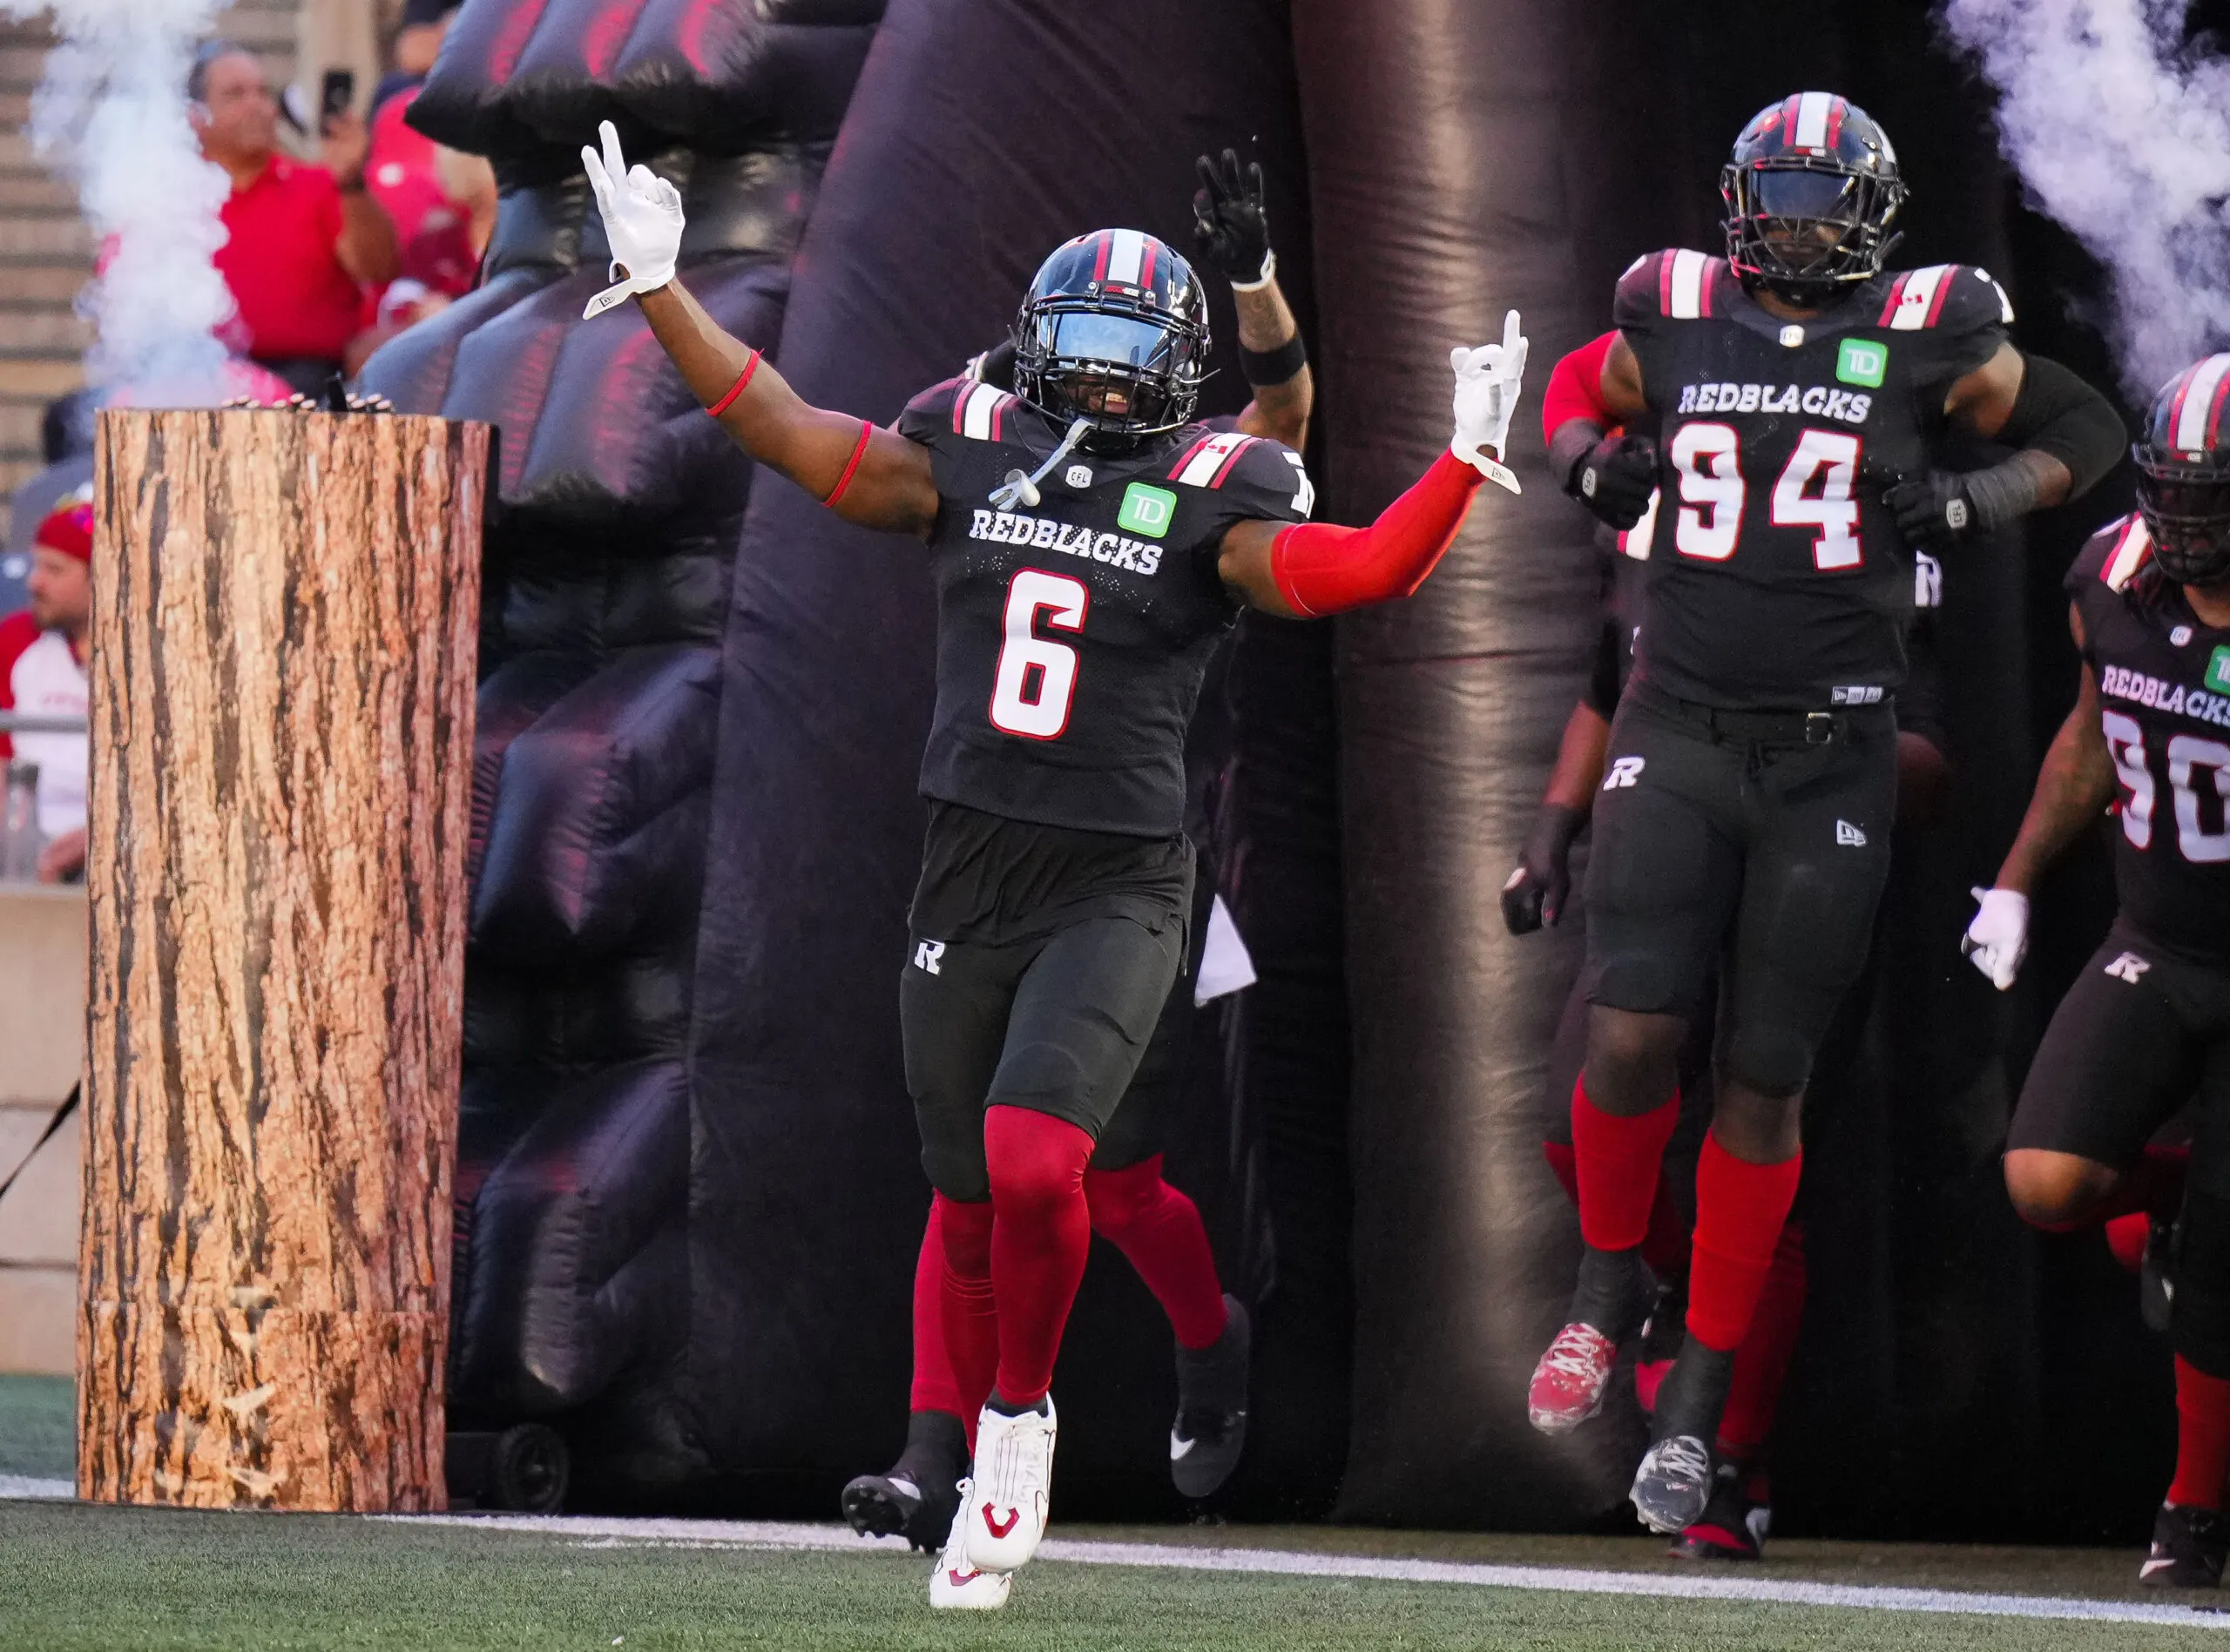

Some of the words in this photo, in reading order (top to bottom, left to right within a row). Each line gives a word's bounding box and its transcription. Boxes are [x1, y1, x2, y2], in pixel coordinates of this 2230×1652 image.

[1846, 347, 1880, 375] TD
[1678, 382, 1873, 424] REDBLACKS
[1071, 471, 1087, 483] CFL
[1132, 494, 1166, 524] TD
[1669, 421, 1864, 572] 94
[969, 509, 1164, 576] REDBLACKS
[988, 566, 1091, 741] 6
[1603, 757, 1645, 791] R
[2102, 708, 2230, 864] 90
[914, 938, 945, 975] R
[2104, 951, 2150, 985] R
